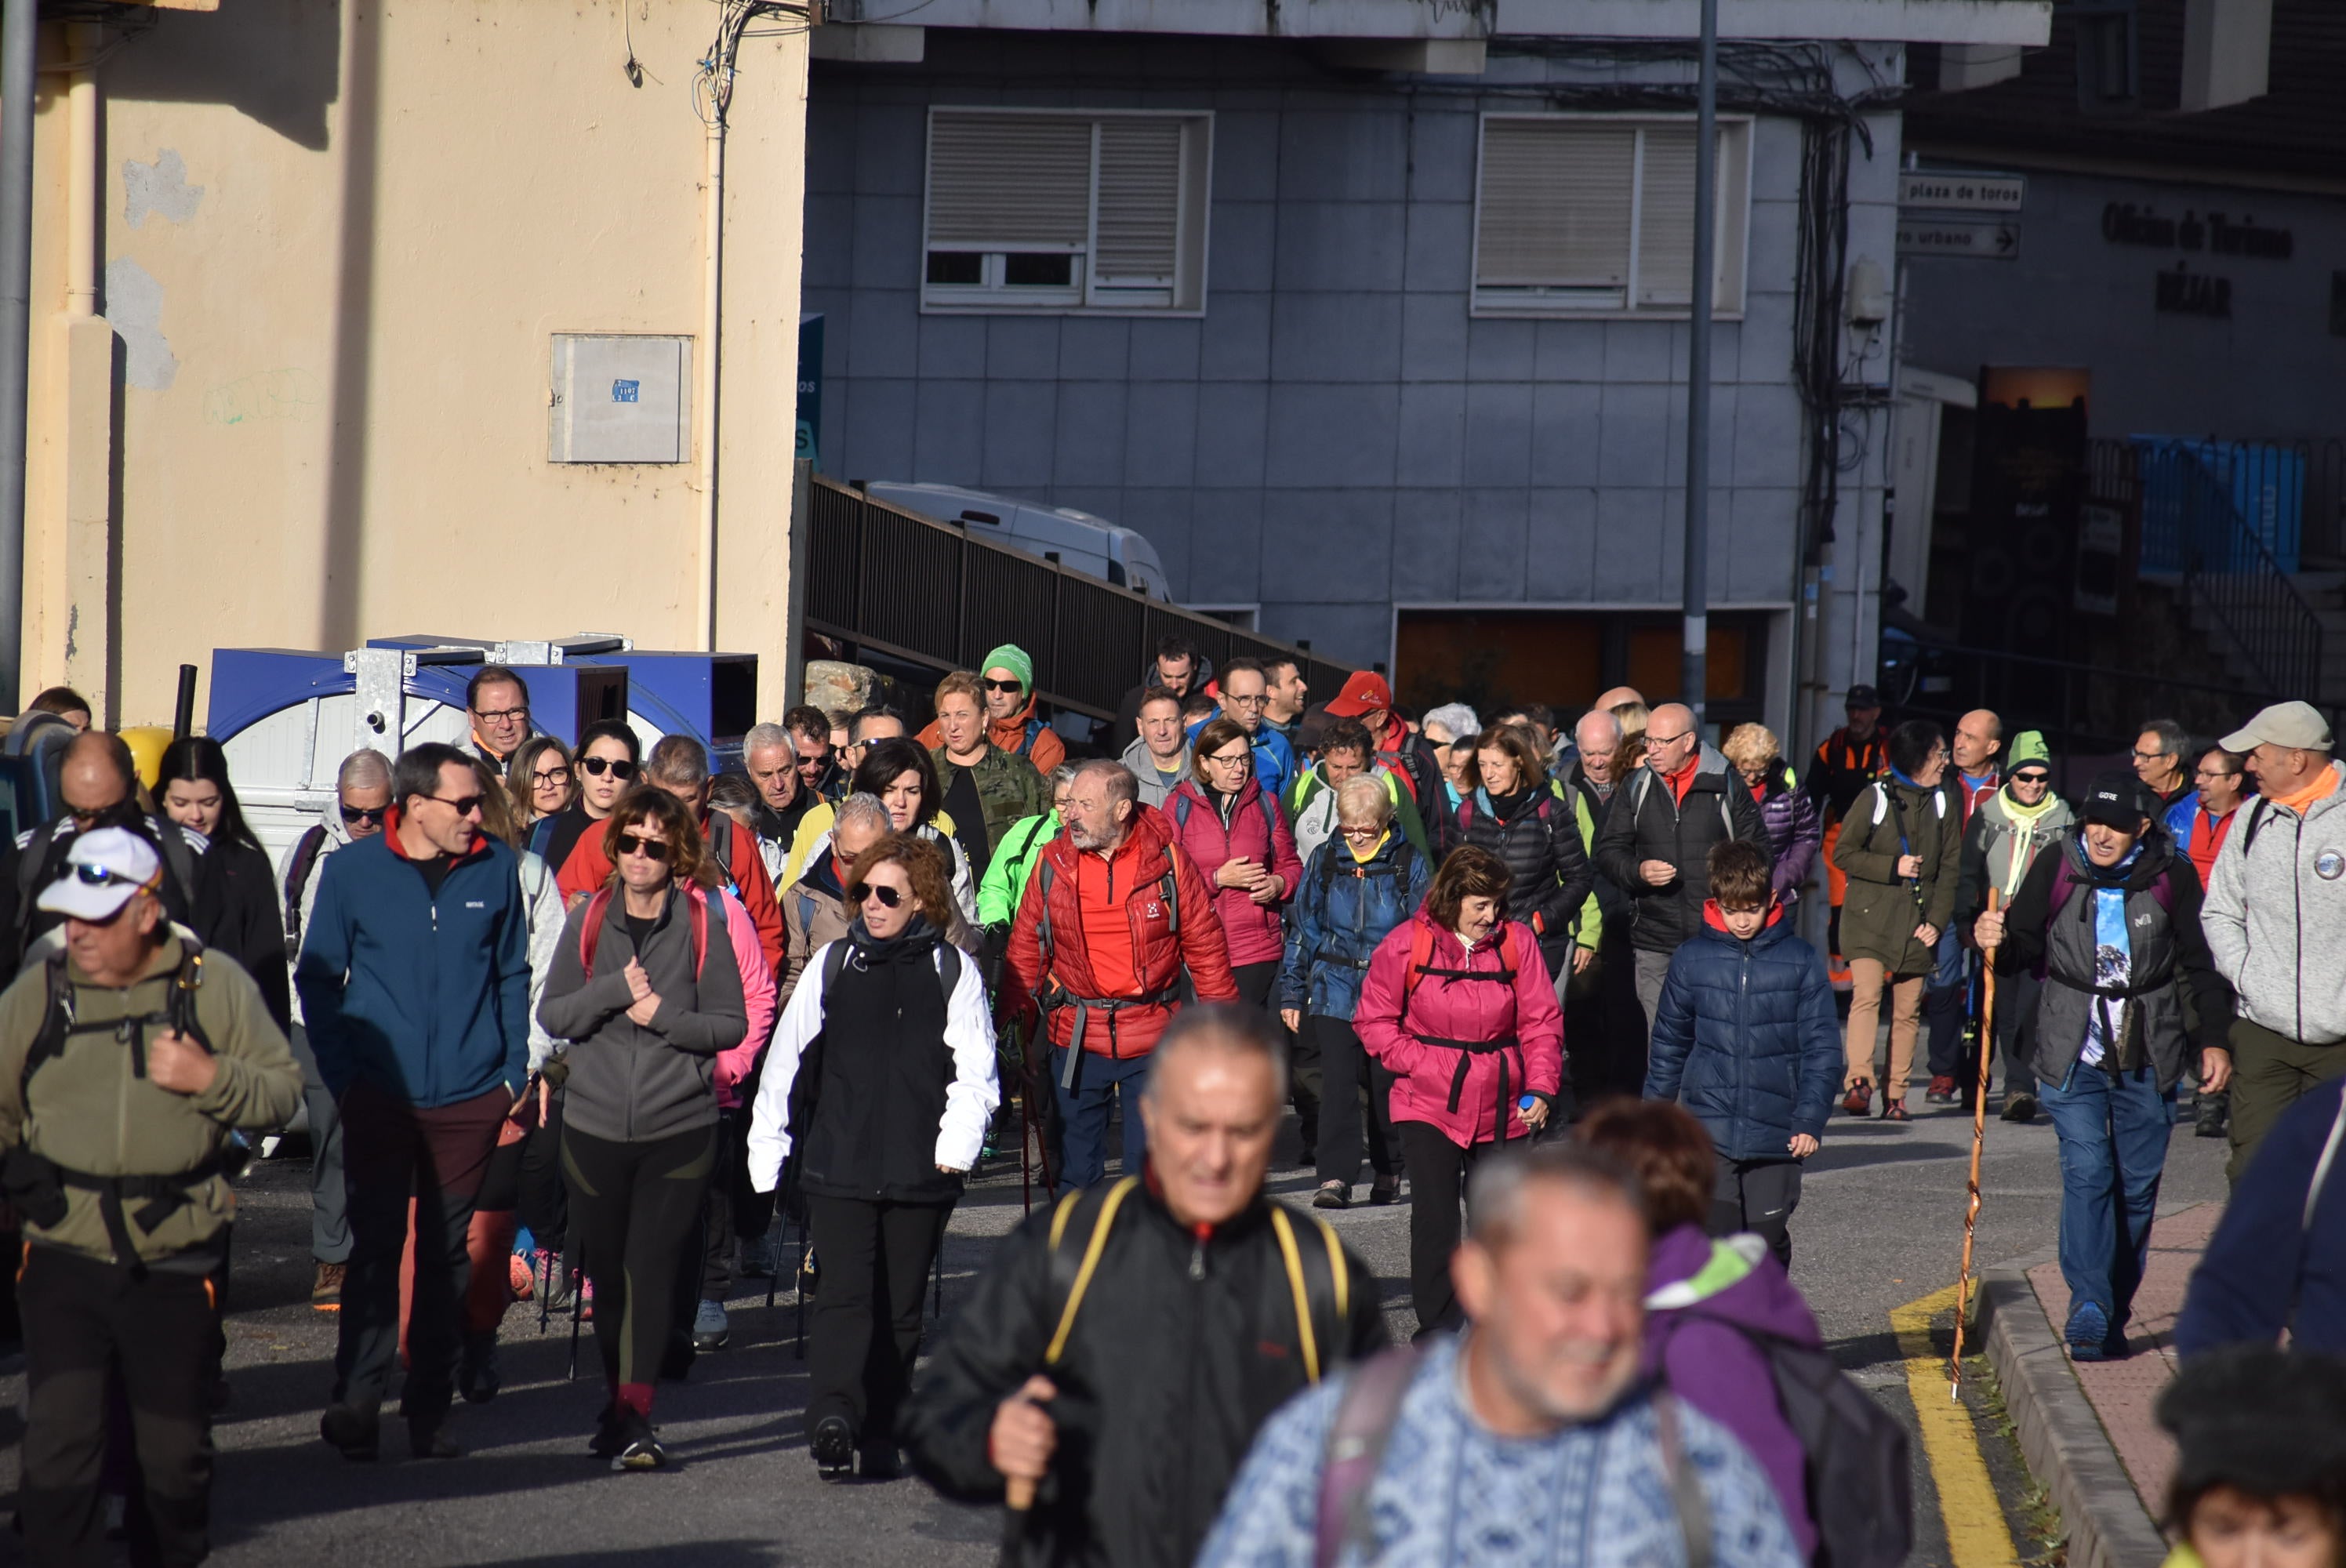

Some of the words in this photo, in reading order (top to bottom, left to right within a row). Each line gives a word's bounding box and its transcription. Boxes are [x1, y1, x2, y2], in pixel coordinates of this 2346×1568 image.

[1908, 183, 1950, 200] plaza
[1956, 186, 1974, 199] de
[1981, 187, 2019, 201] toros
[1918, 231, 1973, 246] urbano
[2101, 201, 2176, 249] Oficina
[2178, 209, 2205, 251] de
[2207, 212, 2295, 261] Turismo
[2098, 791, 2118, 801] GORE
